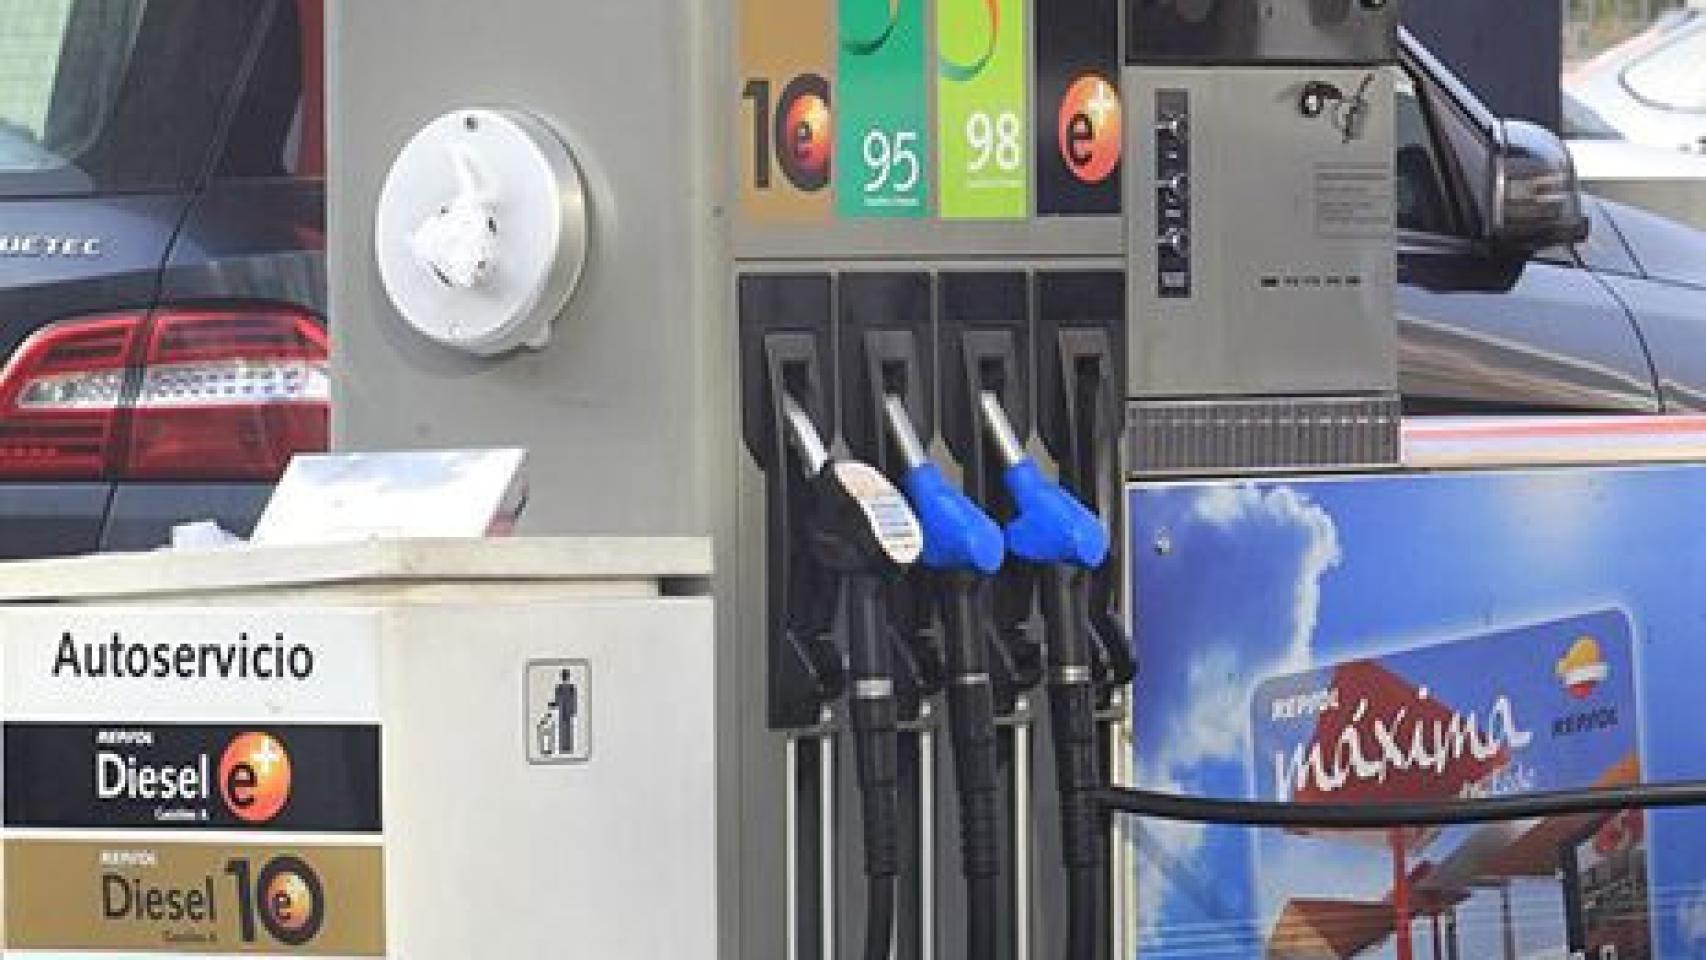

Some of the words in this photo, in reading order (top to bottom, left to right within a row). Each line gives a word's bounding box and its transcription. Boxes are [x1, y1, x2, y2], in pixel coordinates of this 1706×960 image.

[863, 129, 919, 192] 95
[966, 113, 1020, 172] 98
[52, 632, 314, 679] Autoservicio
[97, 752, 209, 799] Diesel
[103, 875, 216, 920] Diesel
